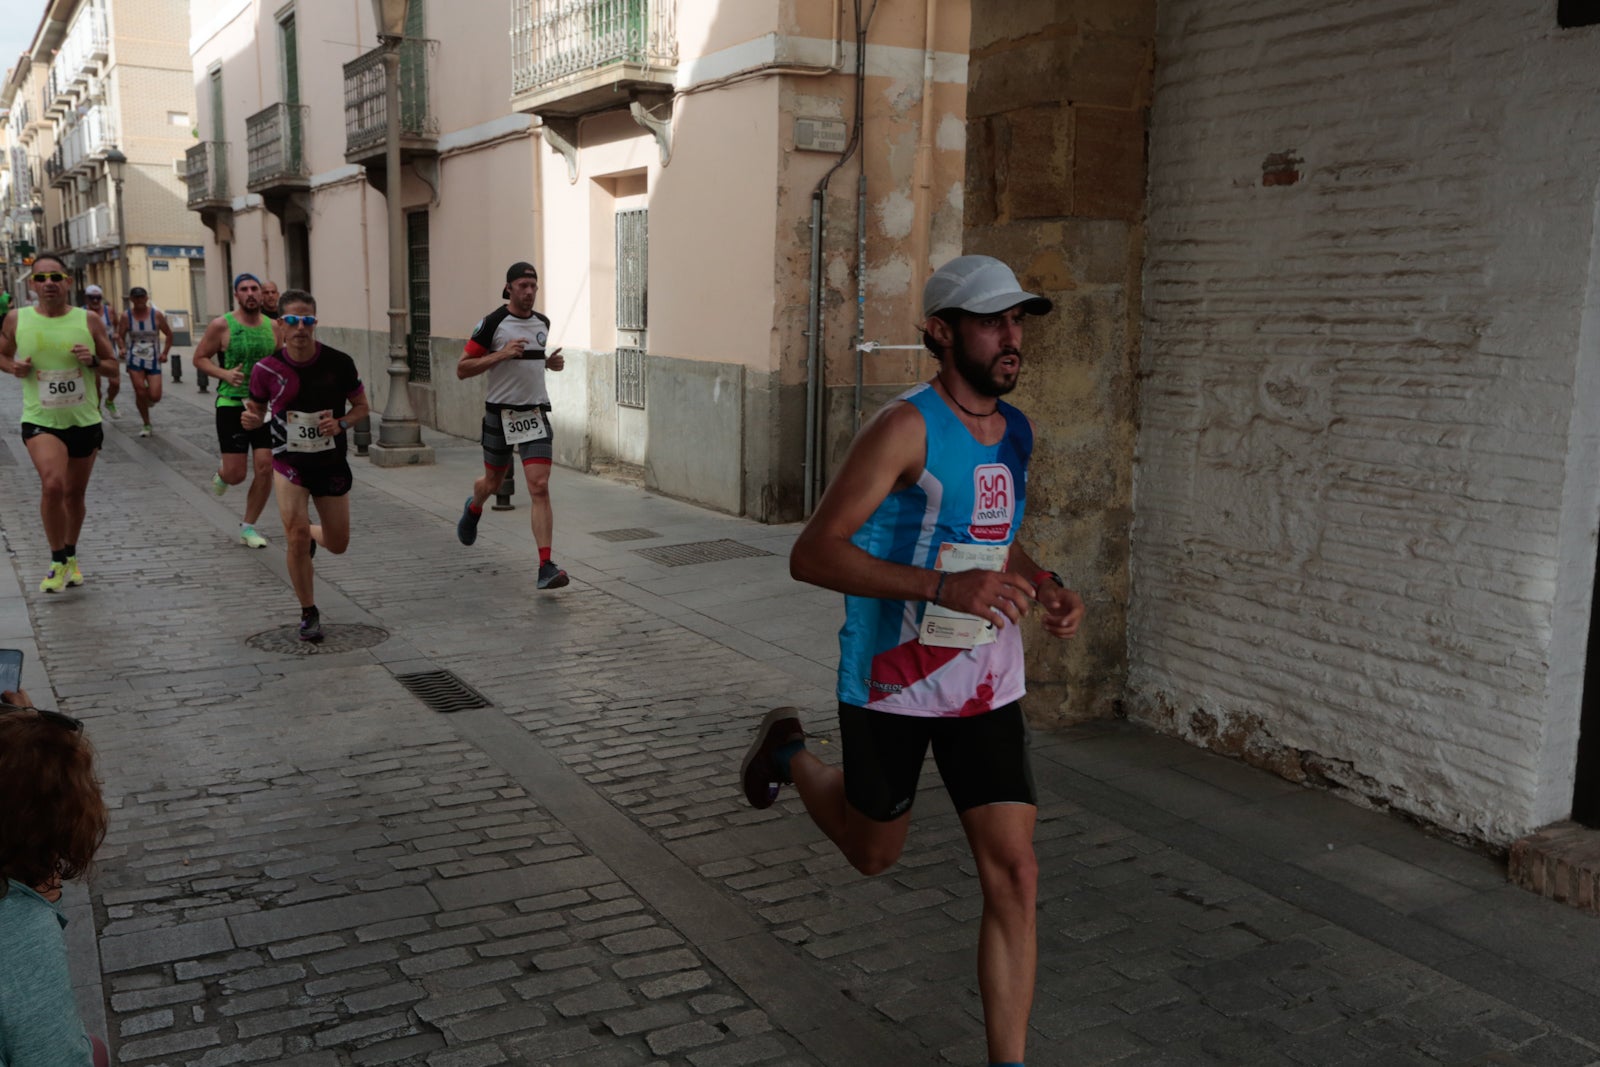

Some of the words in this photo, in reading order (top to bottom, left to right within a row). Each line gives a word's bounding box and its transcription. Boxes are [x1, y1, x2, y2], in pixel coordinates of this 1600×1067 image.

[49, 380, 76, 395] 560
[508, 418, 539, 433] 3005
[979, 474, 1007, 492] run
